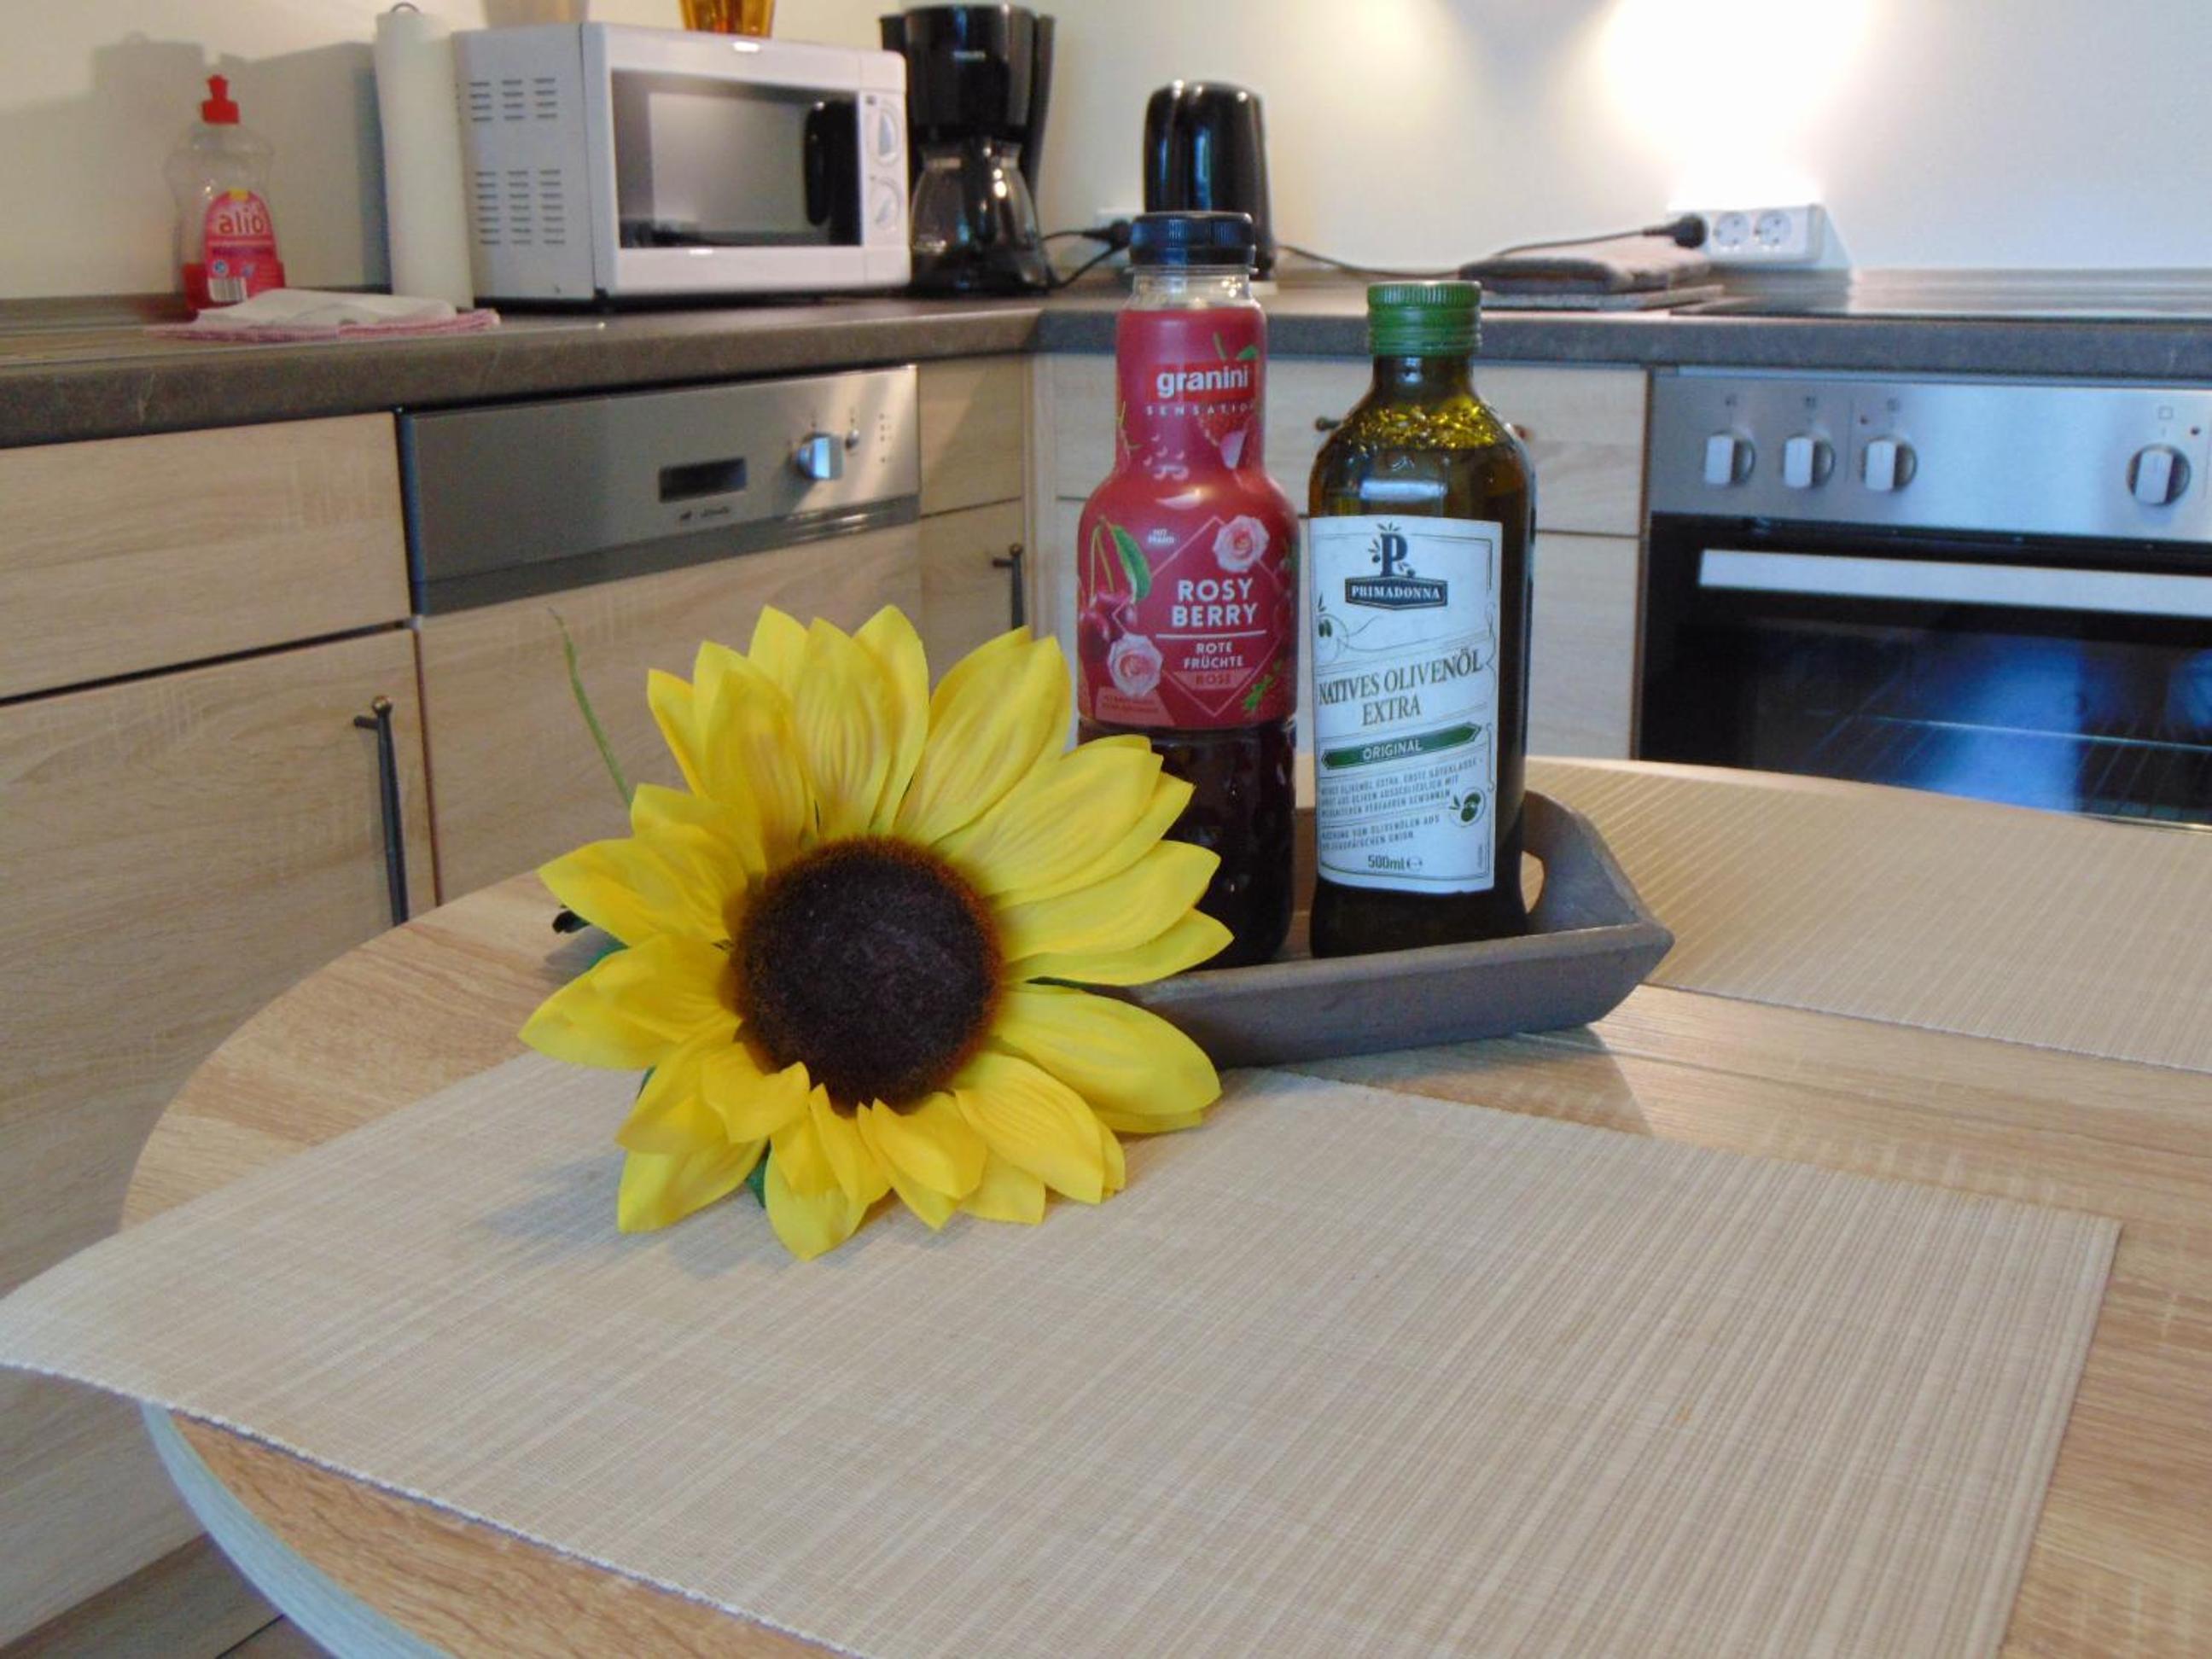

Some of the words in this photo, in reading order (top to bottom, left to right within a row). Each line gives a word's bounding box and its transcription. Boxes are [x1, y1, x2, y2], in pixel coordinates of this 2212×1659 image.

[1156, 365, 1249, 399] granini
[1146, 403, 1254, 416] SENSATIO
[1380, 533, 1408, 577] P
[1178, 578, 1253, 602] ROSY
[1351, 585, 1441, 600] PRIMADONNA
[1172, 602, 1259, 628] BERRY
[1196, 642, 1233, 655] ROTE
[1183, 654, 1244, 670] FRÜCHTE
[1318, 672, 1380, 706] NATIVES
[1383, 649, 1483, 693] OLIVENÖL
[1362, 694, 1422, 726] EXTRA
[1362, 739, 1423, 760] ORIGINAL
[1368, 854, 1406, 870] 500ml
